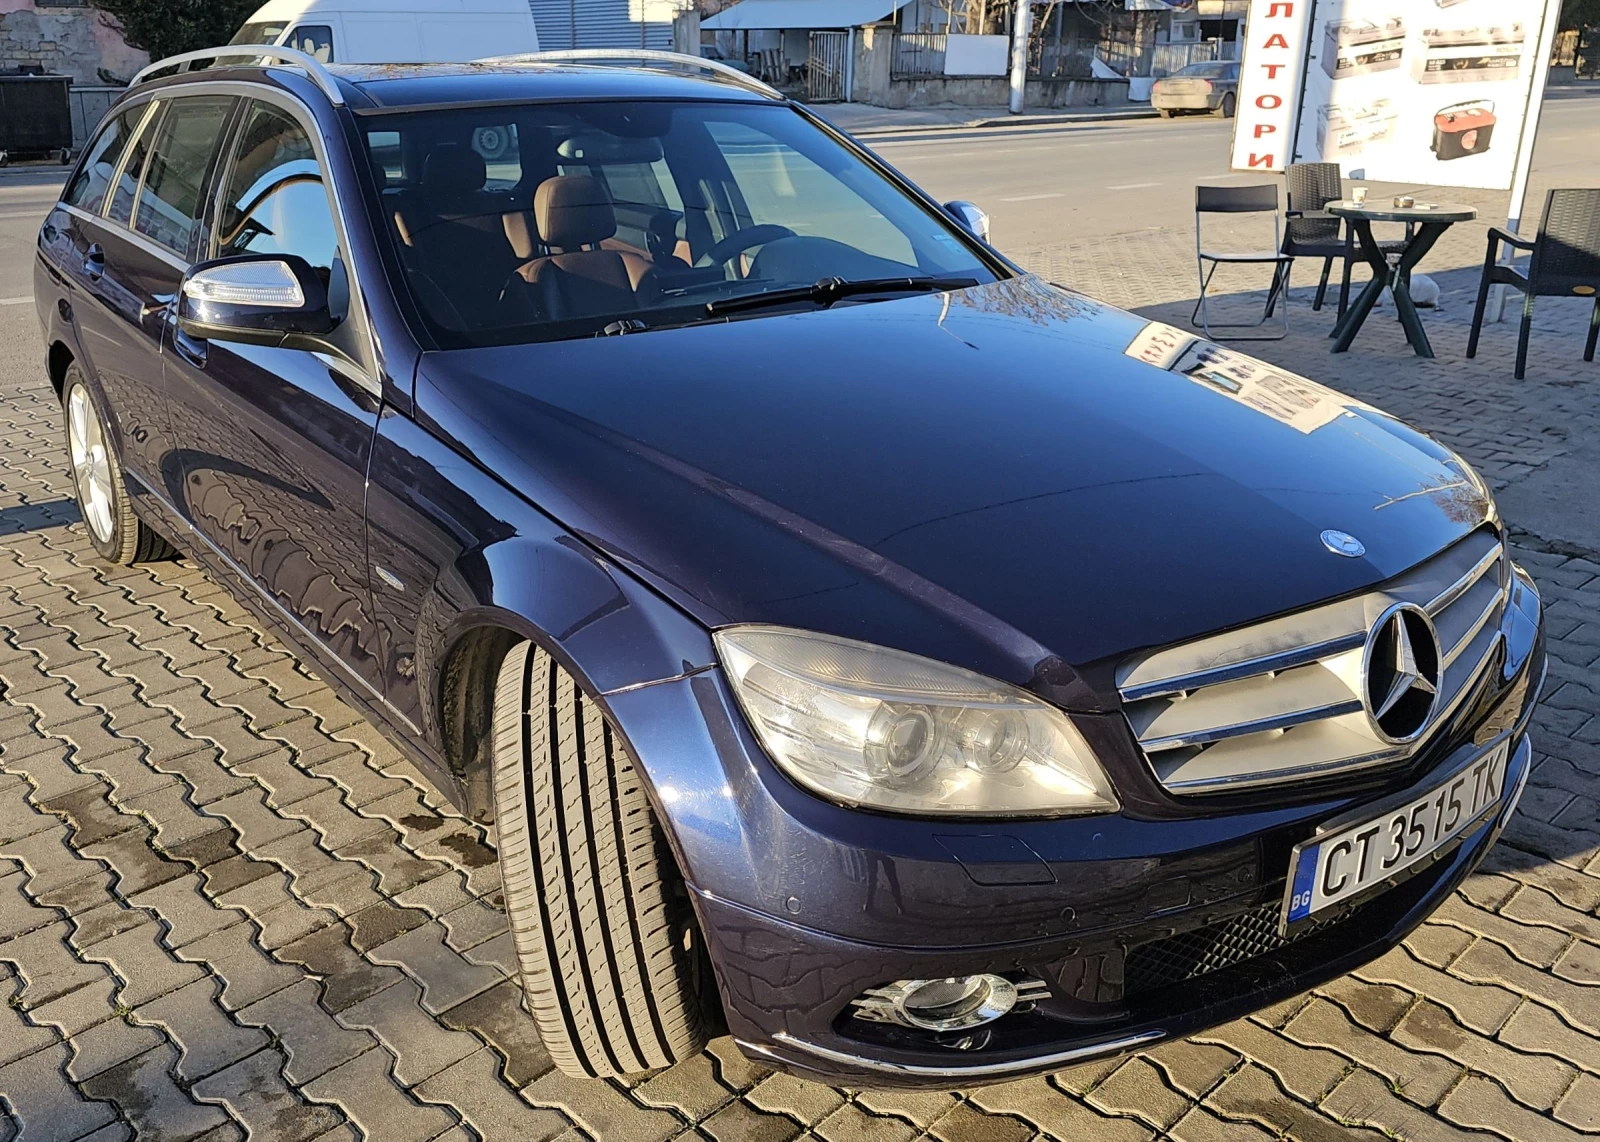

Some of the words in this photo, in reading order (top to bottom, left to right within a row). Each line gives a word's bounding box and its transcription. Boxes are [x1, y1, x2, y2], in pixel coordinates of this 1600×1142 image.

[1248, 2, 1294, 168] ЛАТОРИ
[1321, 825, 1380, 897] CT
[1380, 777, 1465, 870] 3515
[1469, 748, 1504, 817] TK
[1292, 889, 1311, 911] BG
